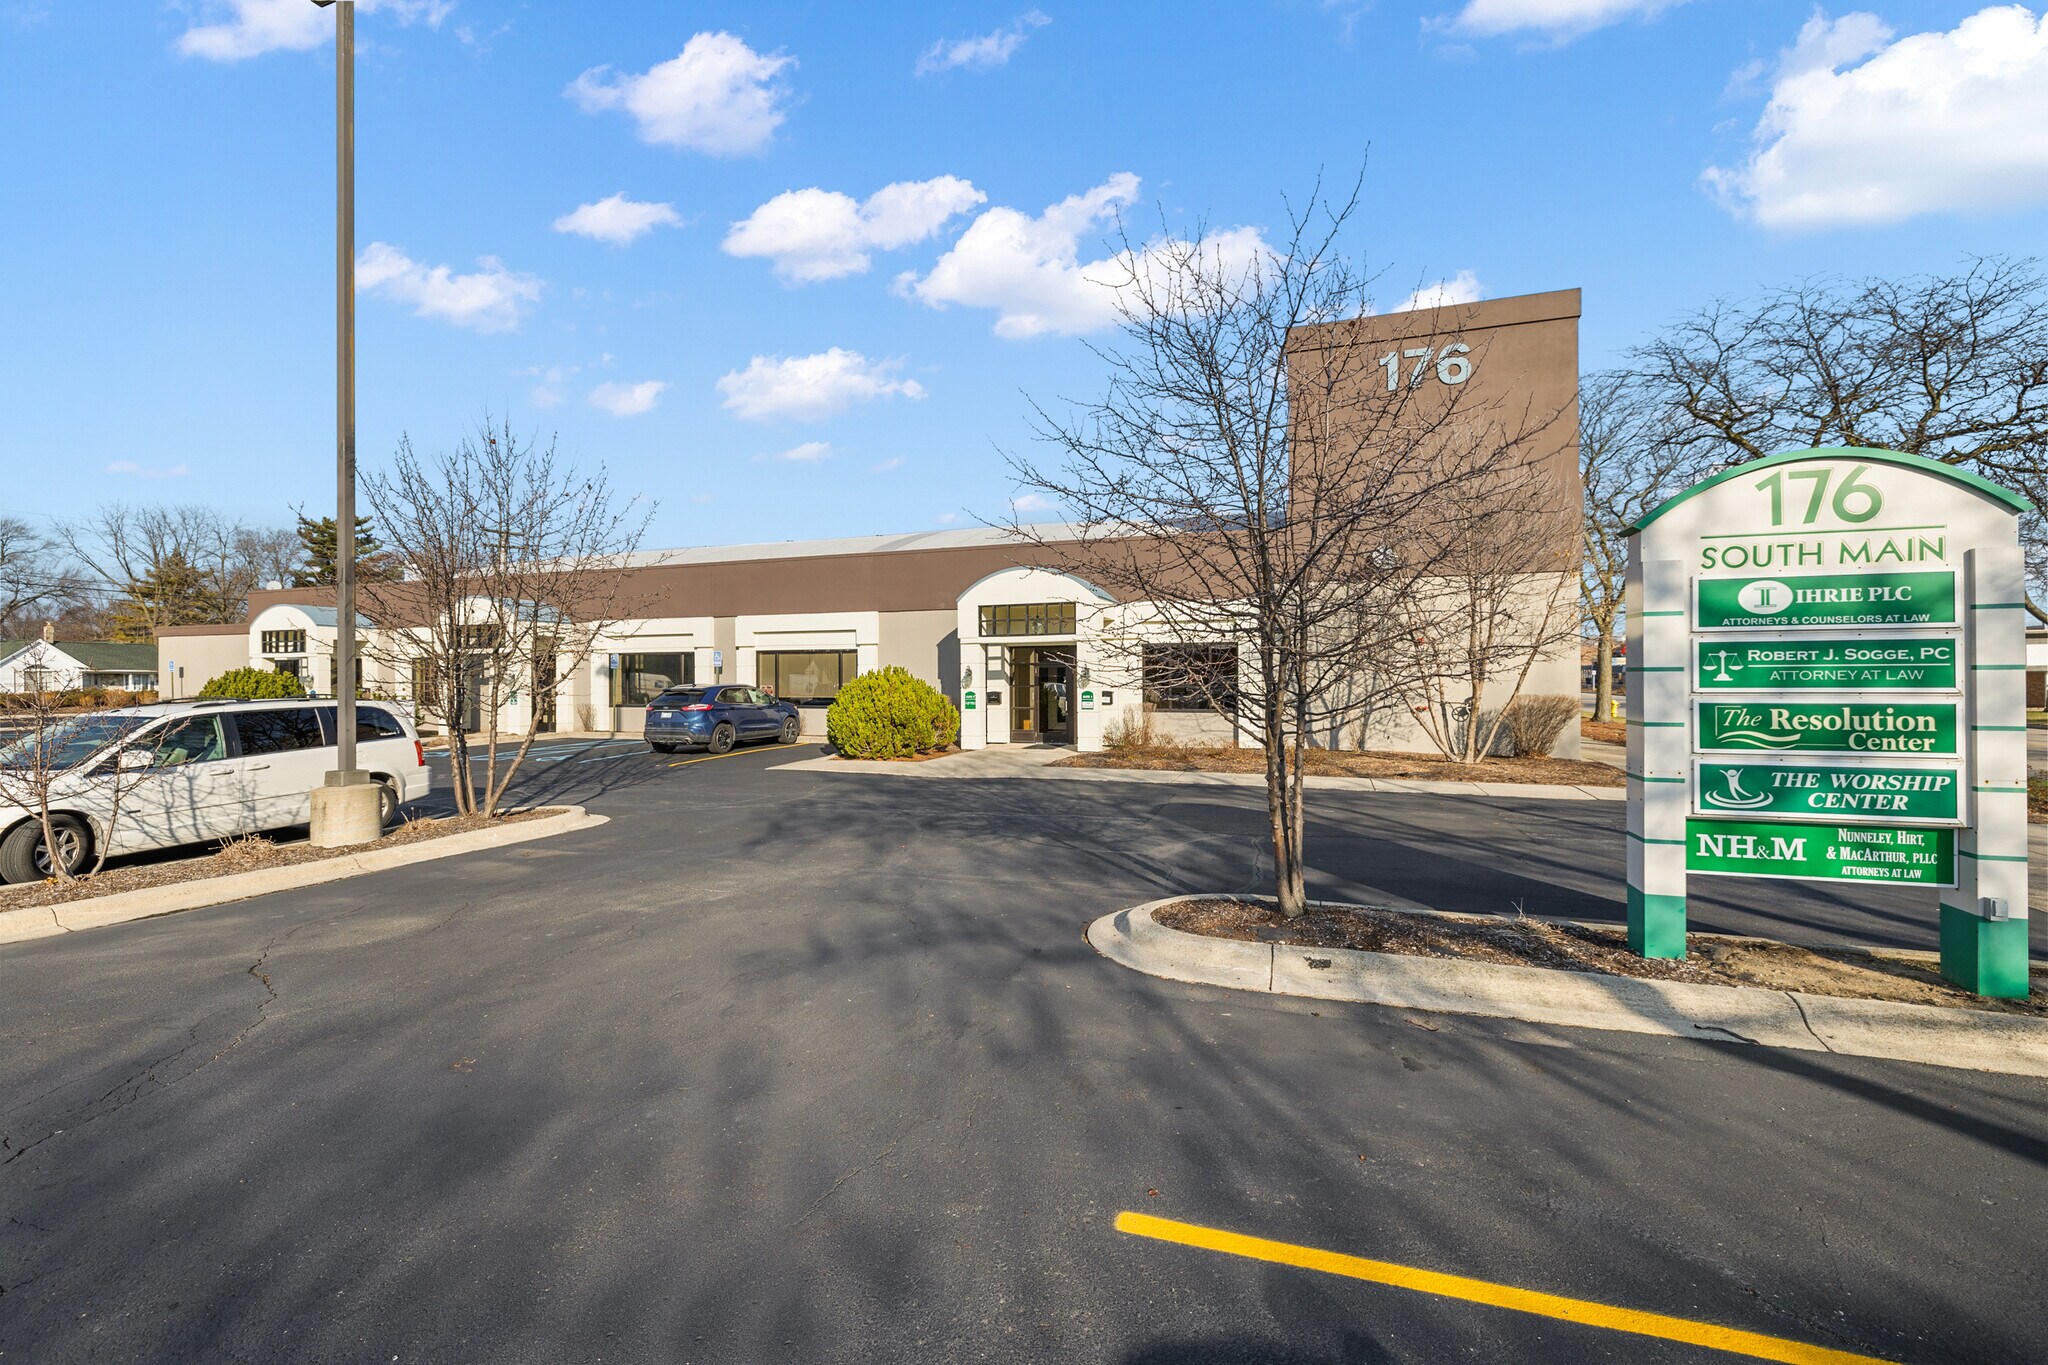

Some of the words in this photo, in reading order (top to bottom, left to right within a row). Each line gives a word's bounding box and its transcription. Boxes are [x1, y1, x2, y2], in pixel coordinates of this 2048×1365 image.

[1378, 342, 1473, 392] 176
[1755, 465, 1884, 527] 176
[1700, 542, 1823, 570] SOUTH
[1839, 536, 1945, 565] MAIN
[1796, 587, 1863, 604] IHRIE
[1868, 585, 1912, 602] PLC
[1722, 616, 1788, 626] ATTORNEYS
[1791, 615, 1799, 625] &
[1801, 614, 1883, 624] COUNSELORS
[1885, 613, 1902, 623] AT
[1904, 613, 1930, 623] LAW
[1747, 649, 1819, 662] ROBERT
[1822, 648, 1839, 661] J.
[1844, 648, 1915, 662] SOGGE,
[1920, 647, 1950, 660] PC
[1769, 669, 1863, 681] ATTORNEY
[1862, 669, 1882, 681] AT
[1886, 669, 1925, 681] LAW
[1723, 708, 1763, 728] The
[1769, 707, 1938, 733] Resolution
[1848, 732, 1936, 752] Center
[1770, 771, 1821, 789] THE
[1830, 773, 1951, 793] WORSHIP
[1807, 792, 1909, 811] CENTER
[1838, 828, 1894, 847] NUNNELEY,
[1896, 830, 1925, 847] HIRT,
[1696, 833, 1808, 862] NH&M
[1825, 846, 1837, 861] &
[1912, 853, 1938, 865] PLLC
[1841, 865, 1890, 878] ATTORNEYS
[1891, 868, 1902, 878] AT
[1903, 868, 1922, 879] LAW
